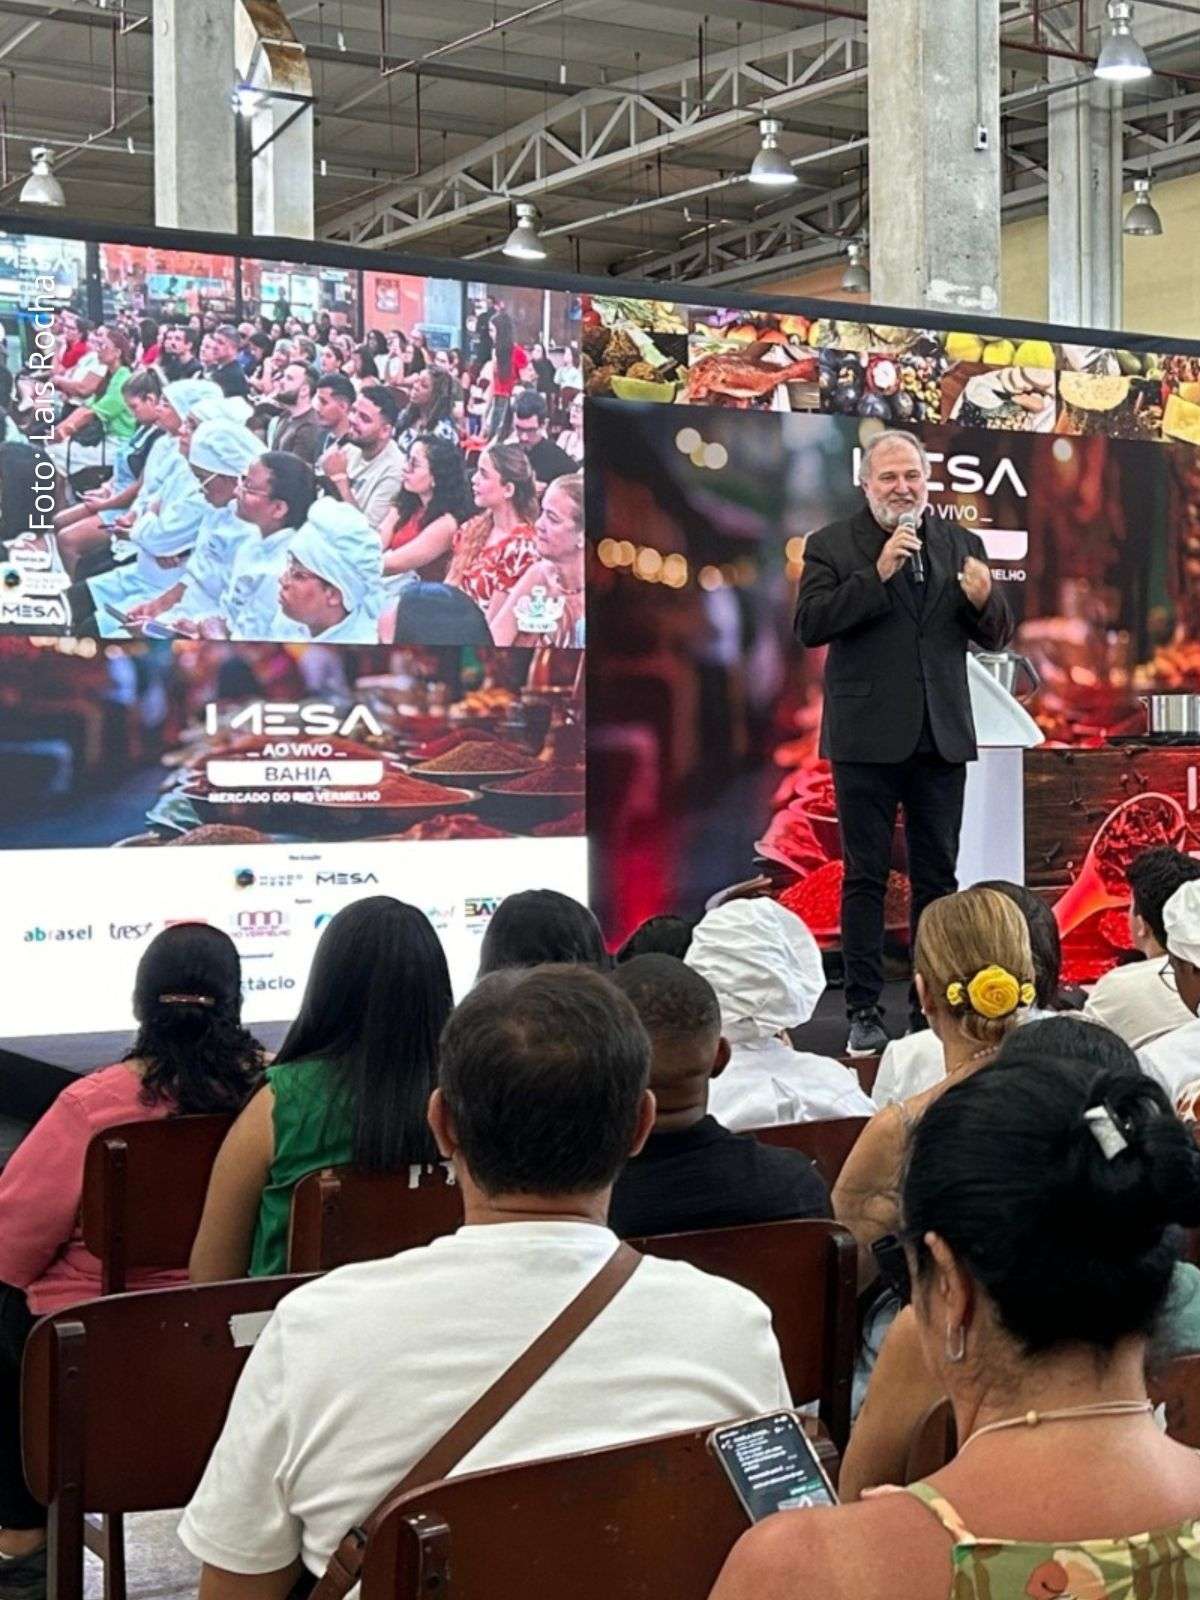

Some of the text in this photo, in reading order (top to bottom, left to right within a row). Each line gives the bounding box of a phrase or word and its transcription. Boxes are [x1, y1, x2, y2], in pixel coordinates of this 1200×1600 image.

[937, 503, 978, 521] VIVO
[3, 604, 60, 617] MESA
[206, 703, 383, 736] MESA
[263, 743, 333, 757] AO VIVO
[265, 766, 332, 781] BAHIA
[208, 792, 270, 803] MERCADO
[272, 792, 291, 803] DO
[316, 791, 381, 802] VERMELHO
[316, 872, 379, 885] MESA
[24, 924, 92, 942] abrasel
[242, 976, 296, 990] tácio
